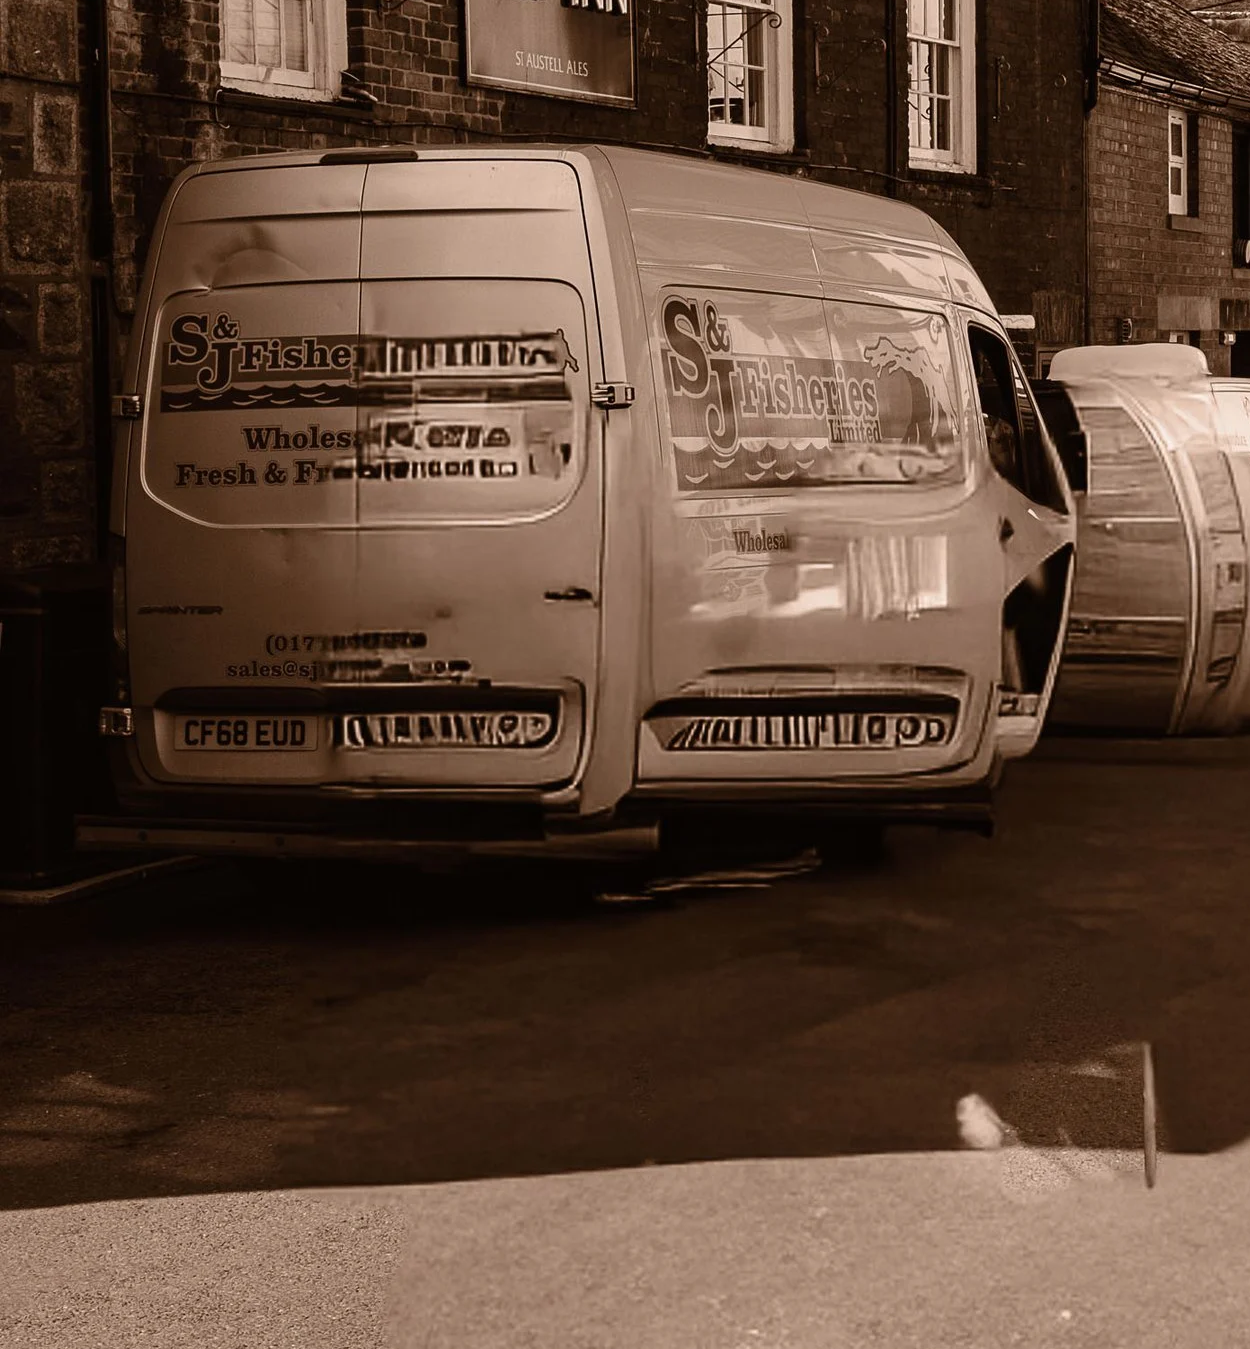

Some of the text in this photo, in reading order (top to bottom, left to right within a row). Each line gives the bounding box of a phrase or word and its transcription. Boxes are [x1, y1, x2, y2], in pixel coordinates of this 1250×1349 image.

[515, 50, 589, 77] ST AUSTELL ALES
[737, 357, 879, 420] Fisheries
[827, 419, 882, 445] Limited
[176, 461, 257, 487] Fresh
[264, 460, 287, 486] &
[137, 605, 224, 616] SPRINTER
[227, 660, 320, 681] sales@sj
[183, 719, 249, 746] CF68
[255, 719, 306, 746] EUD
